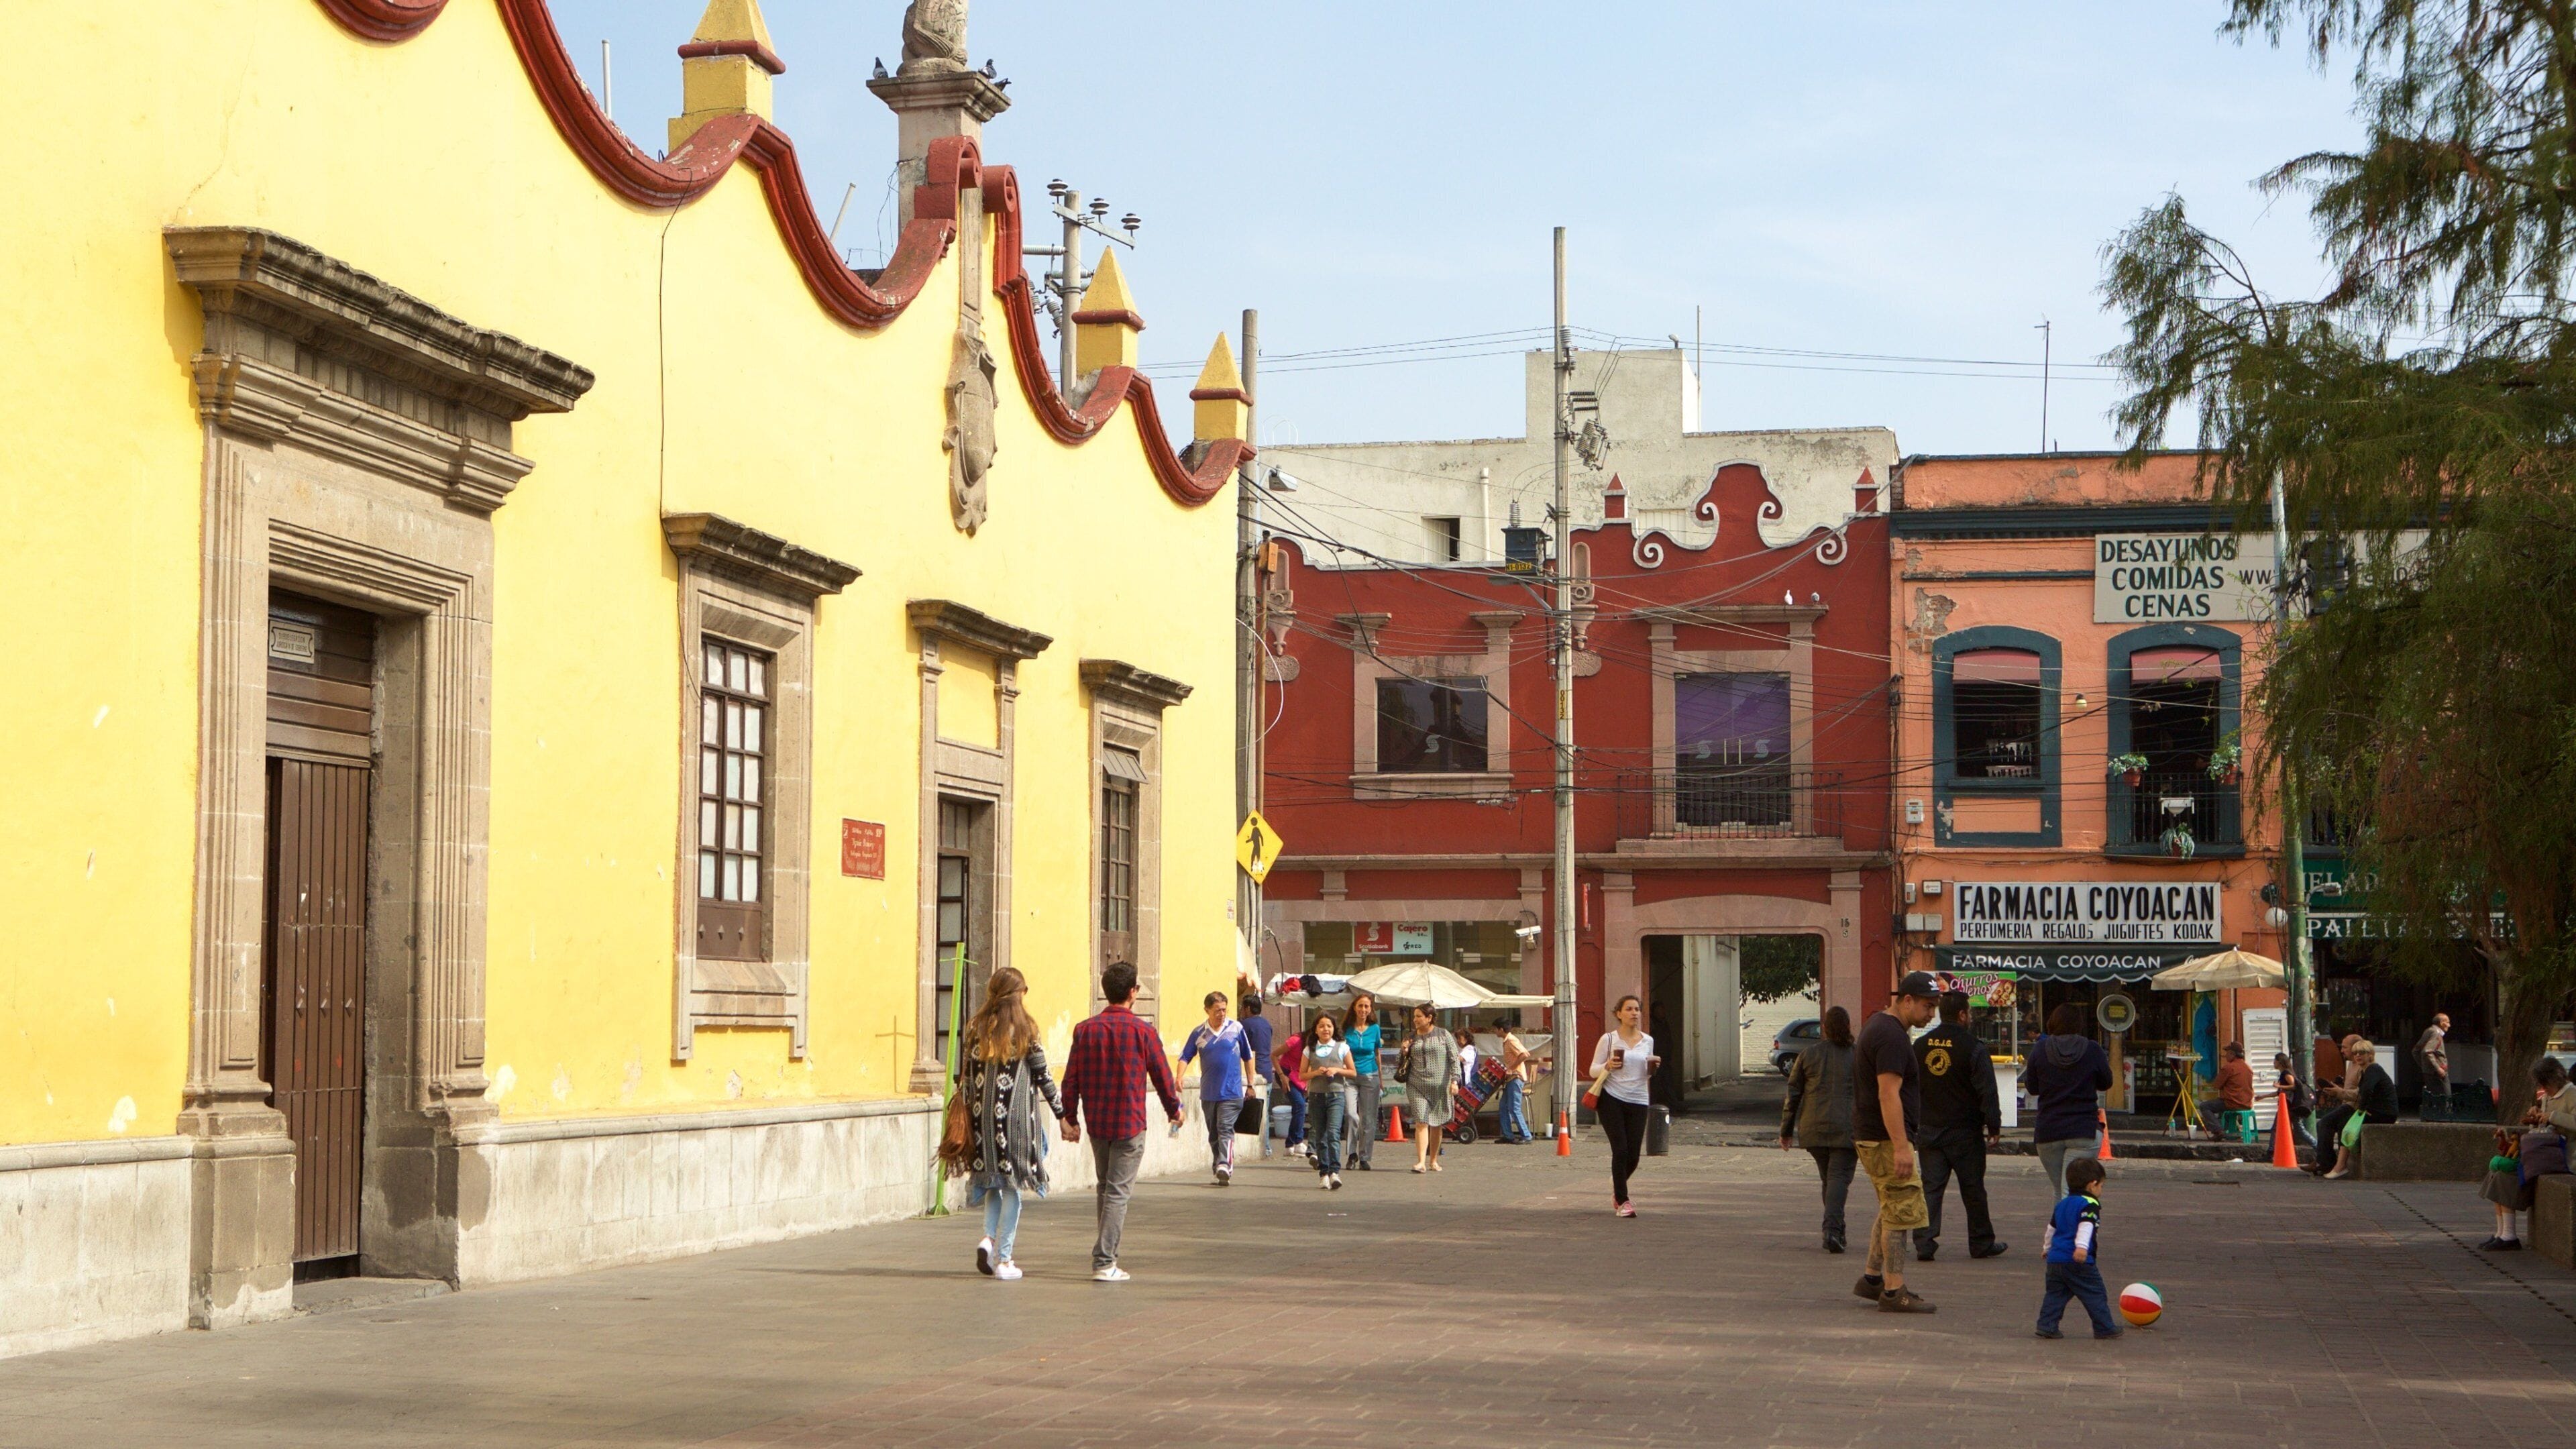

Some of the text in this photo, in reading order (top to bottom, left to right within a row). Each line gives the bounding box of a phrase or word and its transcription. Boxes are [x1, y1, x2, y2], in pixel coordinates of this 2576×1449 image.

[2101, 538, 2237, 563] DESAYUNOS
[2112, 566, 2224, 590] COMIDAS
[2125, 594, 2211, 618] CENAS
[1960, 885, 2214, 920] FARMACIA COYOACAN
[1397, 924, 1428, 934] Cajero
[1960, 922, 2033, 939] PERFUMERIA
[2043, 922, 2094, 939] REGALOS
[2174, 923, 2214, 939] KODAK
[1952, 955, 2161, 969] FARMACIA COYOACAN
